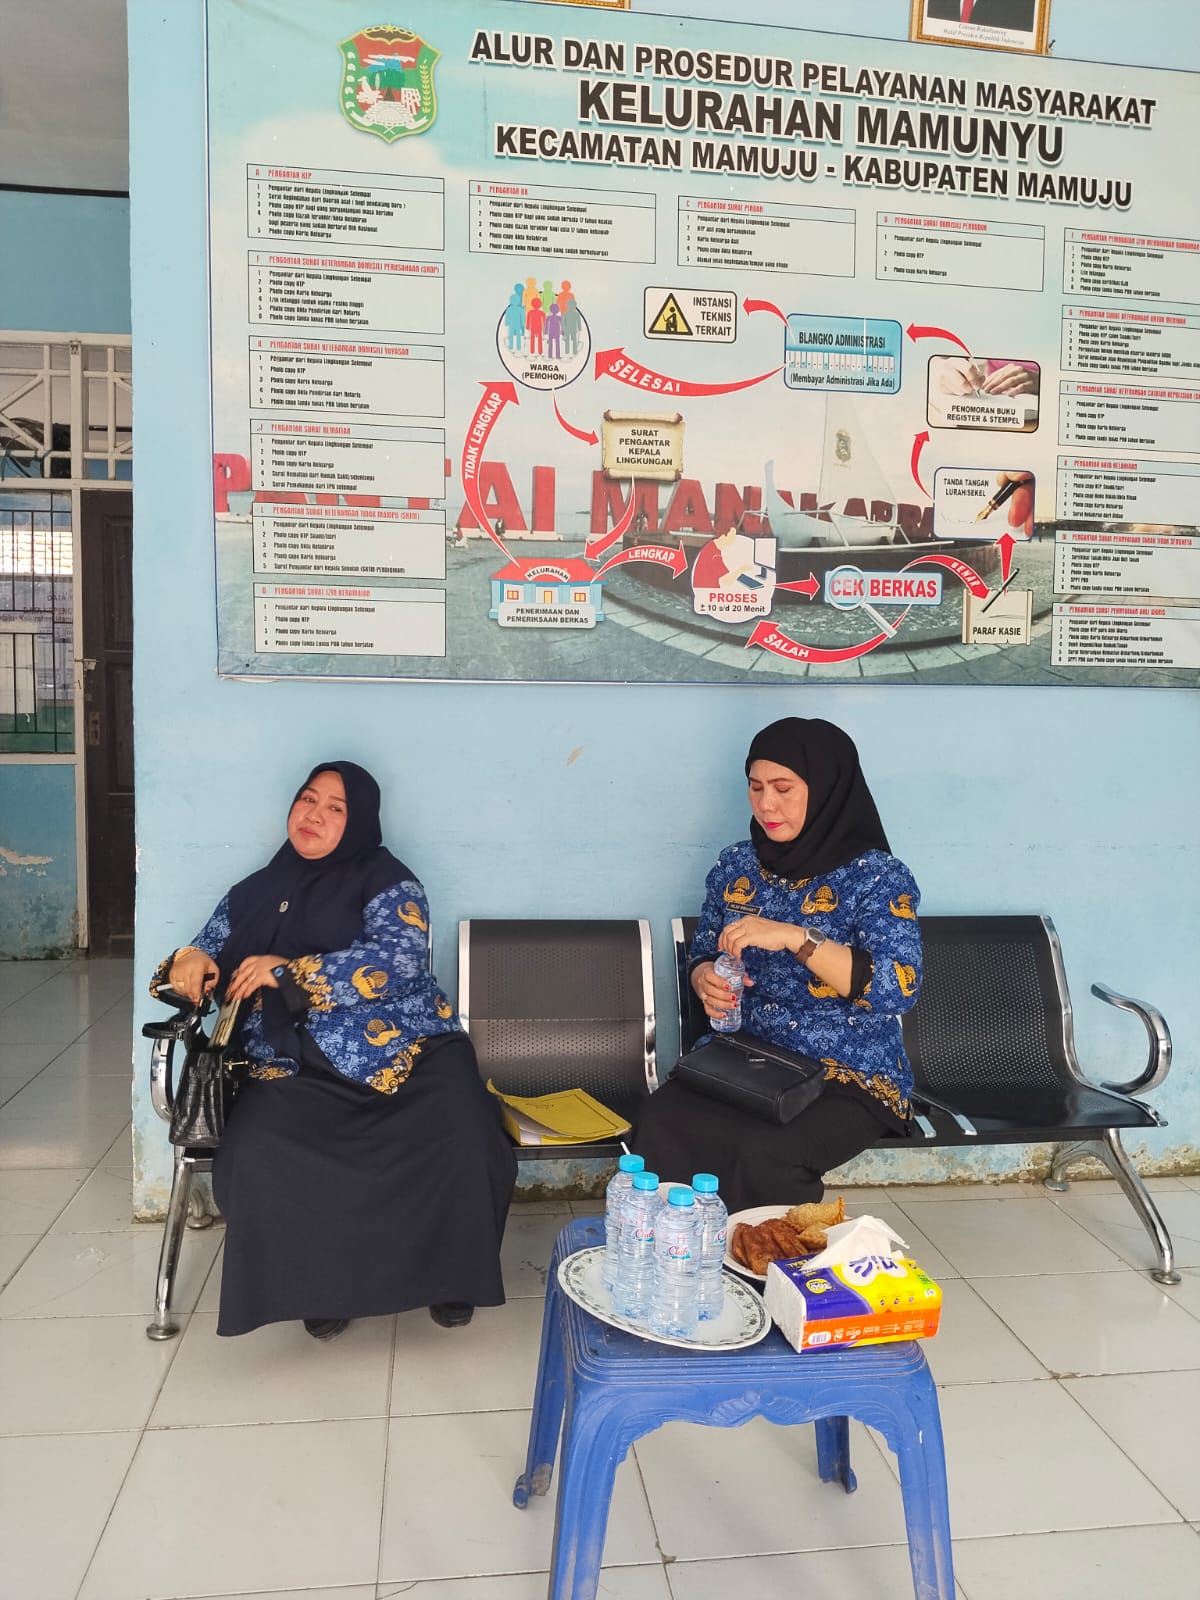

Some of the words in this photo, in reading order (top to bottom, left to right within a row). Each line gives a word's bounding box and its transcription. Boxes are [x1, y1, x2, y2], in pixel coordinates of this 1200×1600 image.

[471, 31, 553, 65] ALUR
[564, 39, 624, 72] DAN
[635, 46, 793, 87] PROSEDUR
[803, 62, 966, 105] PELAYANAN
[976, 81, 1156, 125] MASYARAKAT
[580, 79, 842, 142] KELURAHAN
[857, 105, 1063, 162] MAMUNYU
[496, 126, 681, 167] KECAMATAN
[692, 142, 817, 178] MAMUJU
[845, 155, 1008, 195] KABUPATEN
[1017, 172, 1132, 206] MAMUJU
[268, 170, 300, 179] PENGANTAR
[490, 186, 520, 195] PENGANTAR
[697, 201, 726, 210] PENGANTAR
[895, 217, 922, 226] PENGANTAR
[269, 256, 301, 265] PENGANTAR
[302, 258, 320, 266] SURAT
[321, 259, 356, 268] KETERANGAN
[693, 296, 732, 309] INSTANSI
[700, 311, 732, 322] TEKNIS
[695, 324, 732, 337] TERKAIT
[799, 331, 833, 346] BLANGKO
[835, 334, 886, 349] ADMINISTRASI
[270, 340, 302, 350] PENGANTAR
[322, 343, 357, 353] KETERANGAN
[530, 364, 559, 372] WARGA
[522, 372, 567, 382] (PEMOHON)
[609, 359, 681, 393] SELESAI
[790, 373, 825, 386] (Membayar
[826, 374, 865, 386] Administrasi
[866, 376, 879, 387] Jika
[880, 377, 895, 388] Ada)
[951, 405, 995, 414] PENOMORAN
[996, 407, 1016, 416] BUKU
[947, 413, 980, 422] REGISTER
[983, 415, 988, 423] &
[989, 416, 1020, 425] STEMPEL
[271, 424, 303, 433] PENGANTAR
[304, 425, 321, 433] SURAT
[631, 429, 659, 437] SURAT
[464, 447, 480, 480] TIDAK
[472, 392, 503, 445] LENGKAP
[619, 438, 671, 447] PENGANTAR
[628, 447, 661, 457] KEPALA
[616, 456, 673, 466] LINGKUNGAN
[944, 478, 963, 486] TANDA
[965, 479, 989, 487] TANGAN
[272, 507, 305, 516] PENGANTAR
[306, 508, 323, 516] SURAT
[324, 509, 360, 518] KETERANGAN
[629, 548, 675, 563] LENGKAP
[526, 566, 570, 581] KELURAHAN
[950, 561, 982, 589] BENAR
[275, 587, 305, 595] PENGANTAR
[306, 588, 324, 596] SURAT
[830, 578, 865, 597] CEK
[870, 579, 937, 598] BERKAS
[709, 592, 758, 604] PROSES
[708, 604, 717, 612] 10
[719, 604, 730, 612] s/d
[743, 605, 765, 613] Menit
[506, 615, 558, 624] PEMERIKSAAN
[560, 616, 589, 624] BERKAS
[973, 626, 996, 635] PARAF
[998, 627, 1022, 635] KASIE
[763, 633, 809, 658] SALAH
